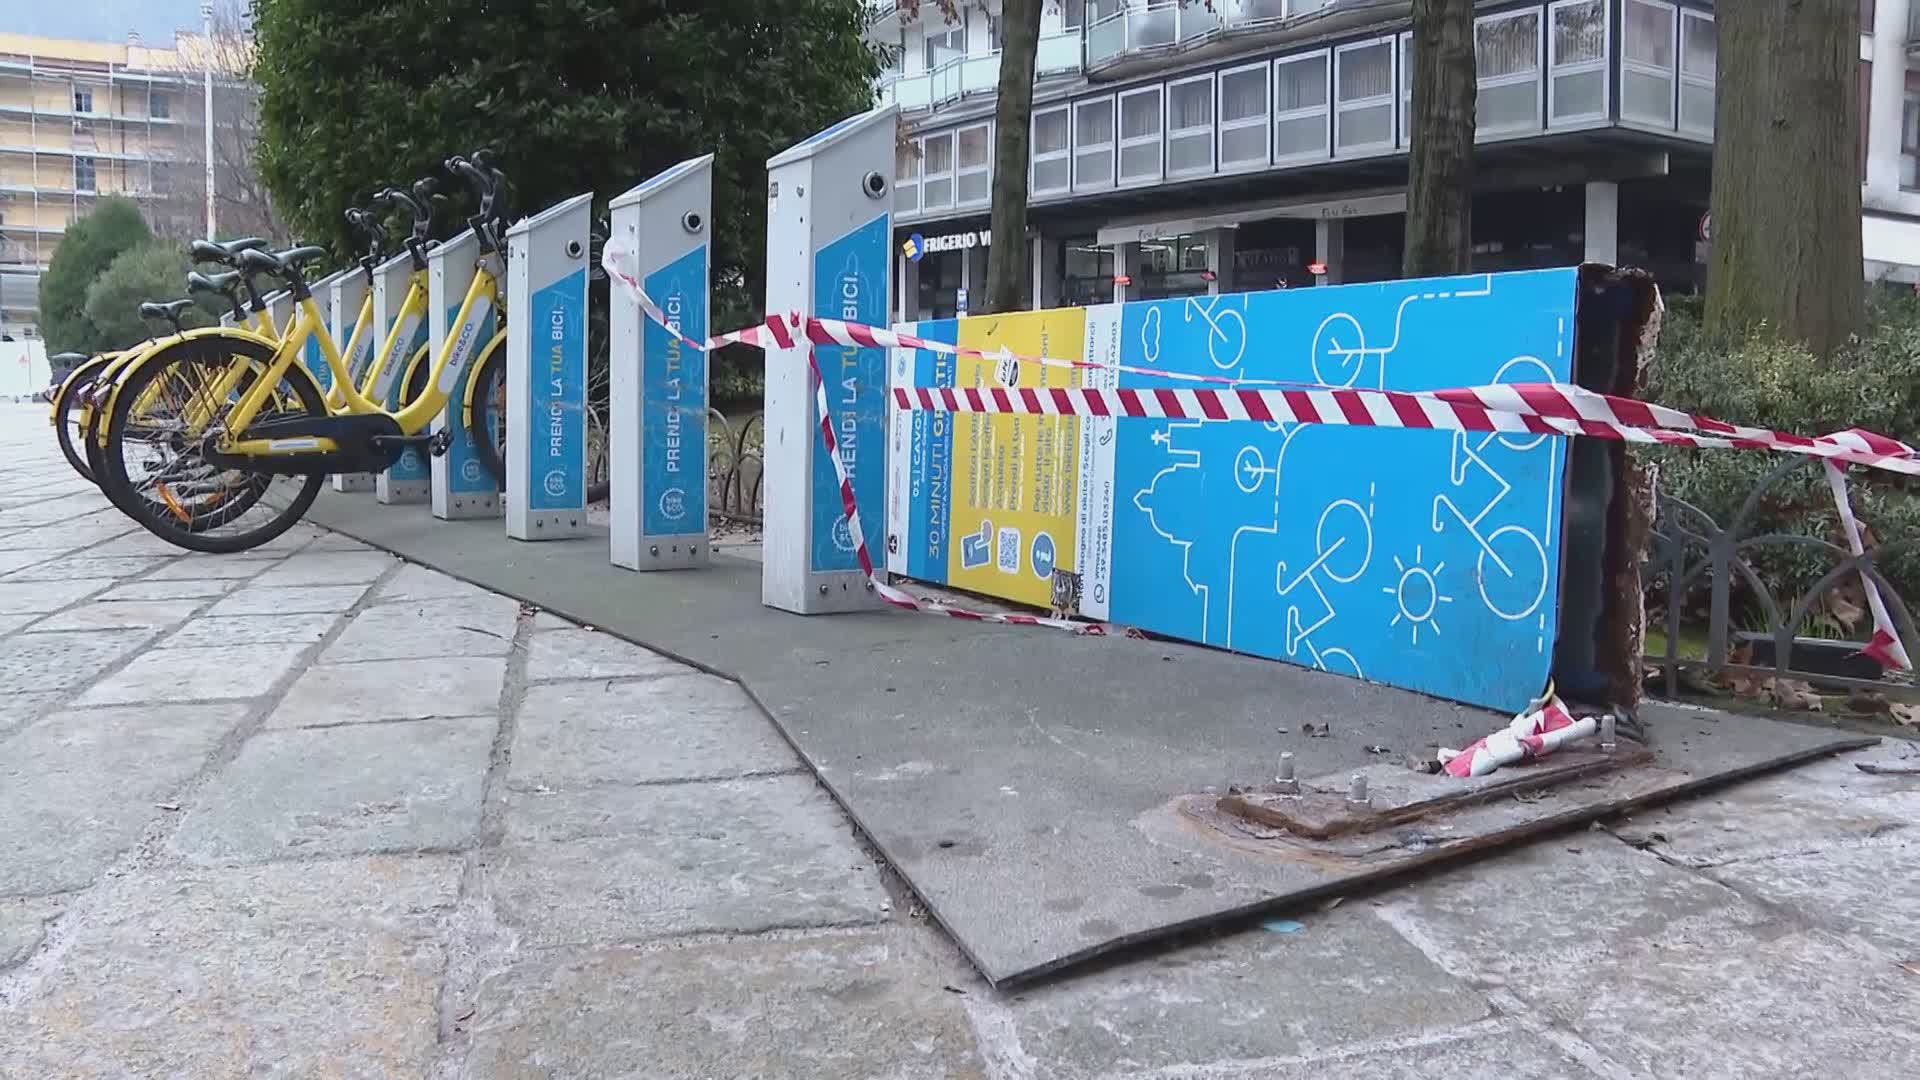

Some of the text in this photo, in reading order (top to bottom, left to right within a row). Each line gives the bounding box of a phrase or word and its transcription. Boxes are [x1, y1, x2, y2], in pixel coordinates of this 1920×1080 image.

[924, 229, 991, 253] FRIGERIO VI
[551, 345, 562, 374] TUA
[666, 338, 681, 373] TUA
[841, 345, 857, 370] TU
[551, 379, 563, 397] LA
[666, 378, 681, 401] LA
[841, 377, 857, 404] LA
[841, 411, 857, 491] RENDI
[913, 410, 921, 466] CAVOU
[928, 351, 946, 559] 30 MINUTI GRTIS
